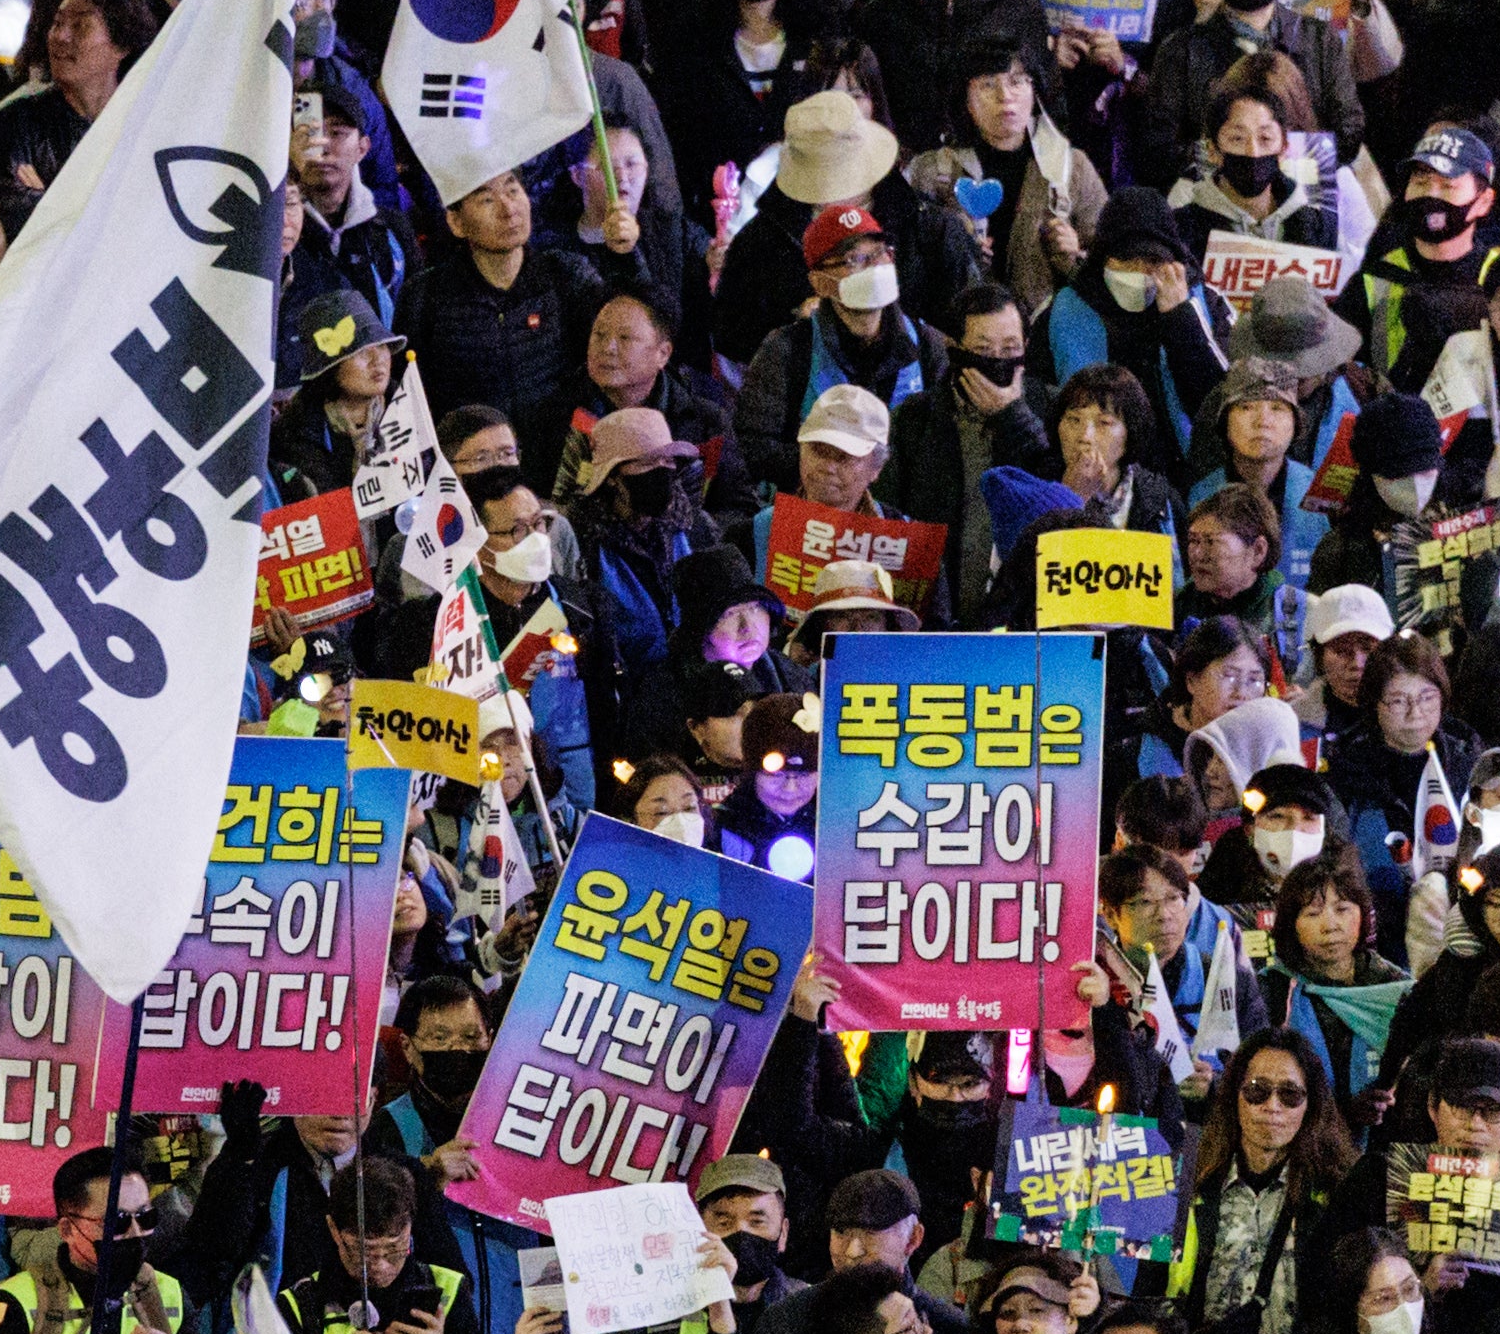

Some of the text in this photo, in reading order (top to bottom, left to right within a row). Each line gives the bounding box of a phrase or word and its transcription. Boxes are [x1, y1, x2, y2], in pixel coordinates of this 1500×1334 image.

[1205, 253, 1343, 299] 내란수괴
[277, 549, 359, 601] 파면!
[803, 520, 907, 572] 윤석열
[1045, 560, 1162, 597] 천안아산
[357, 706, 470, 754] 천안아산
[838, 684, 1082, 768] 폭동범은
[858, 783, 1052, 865] 수갑이
[183, 876, 336, 959] 속이
[554, 870, 780, 1028] 윤석열은
[845, 882, 1061, 963] 답이다!
[139, 971, 349, 1050] 답이다!
[541, 973, 717, 1119] 파면이
[900, 1002, 949, 1020] 천안아산
[495, 1064, 705, 1175] 답이다!
